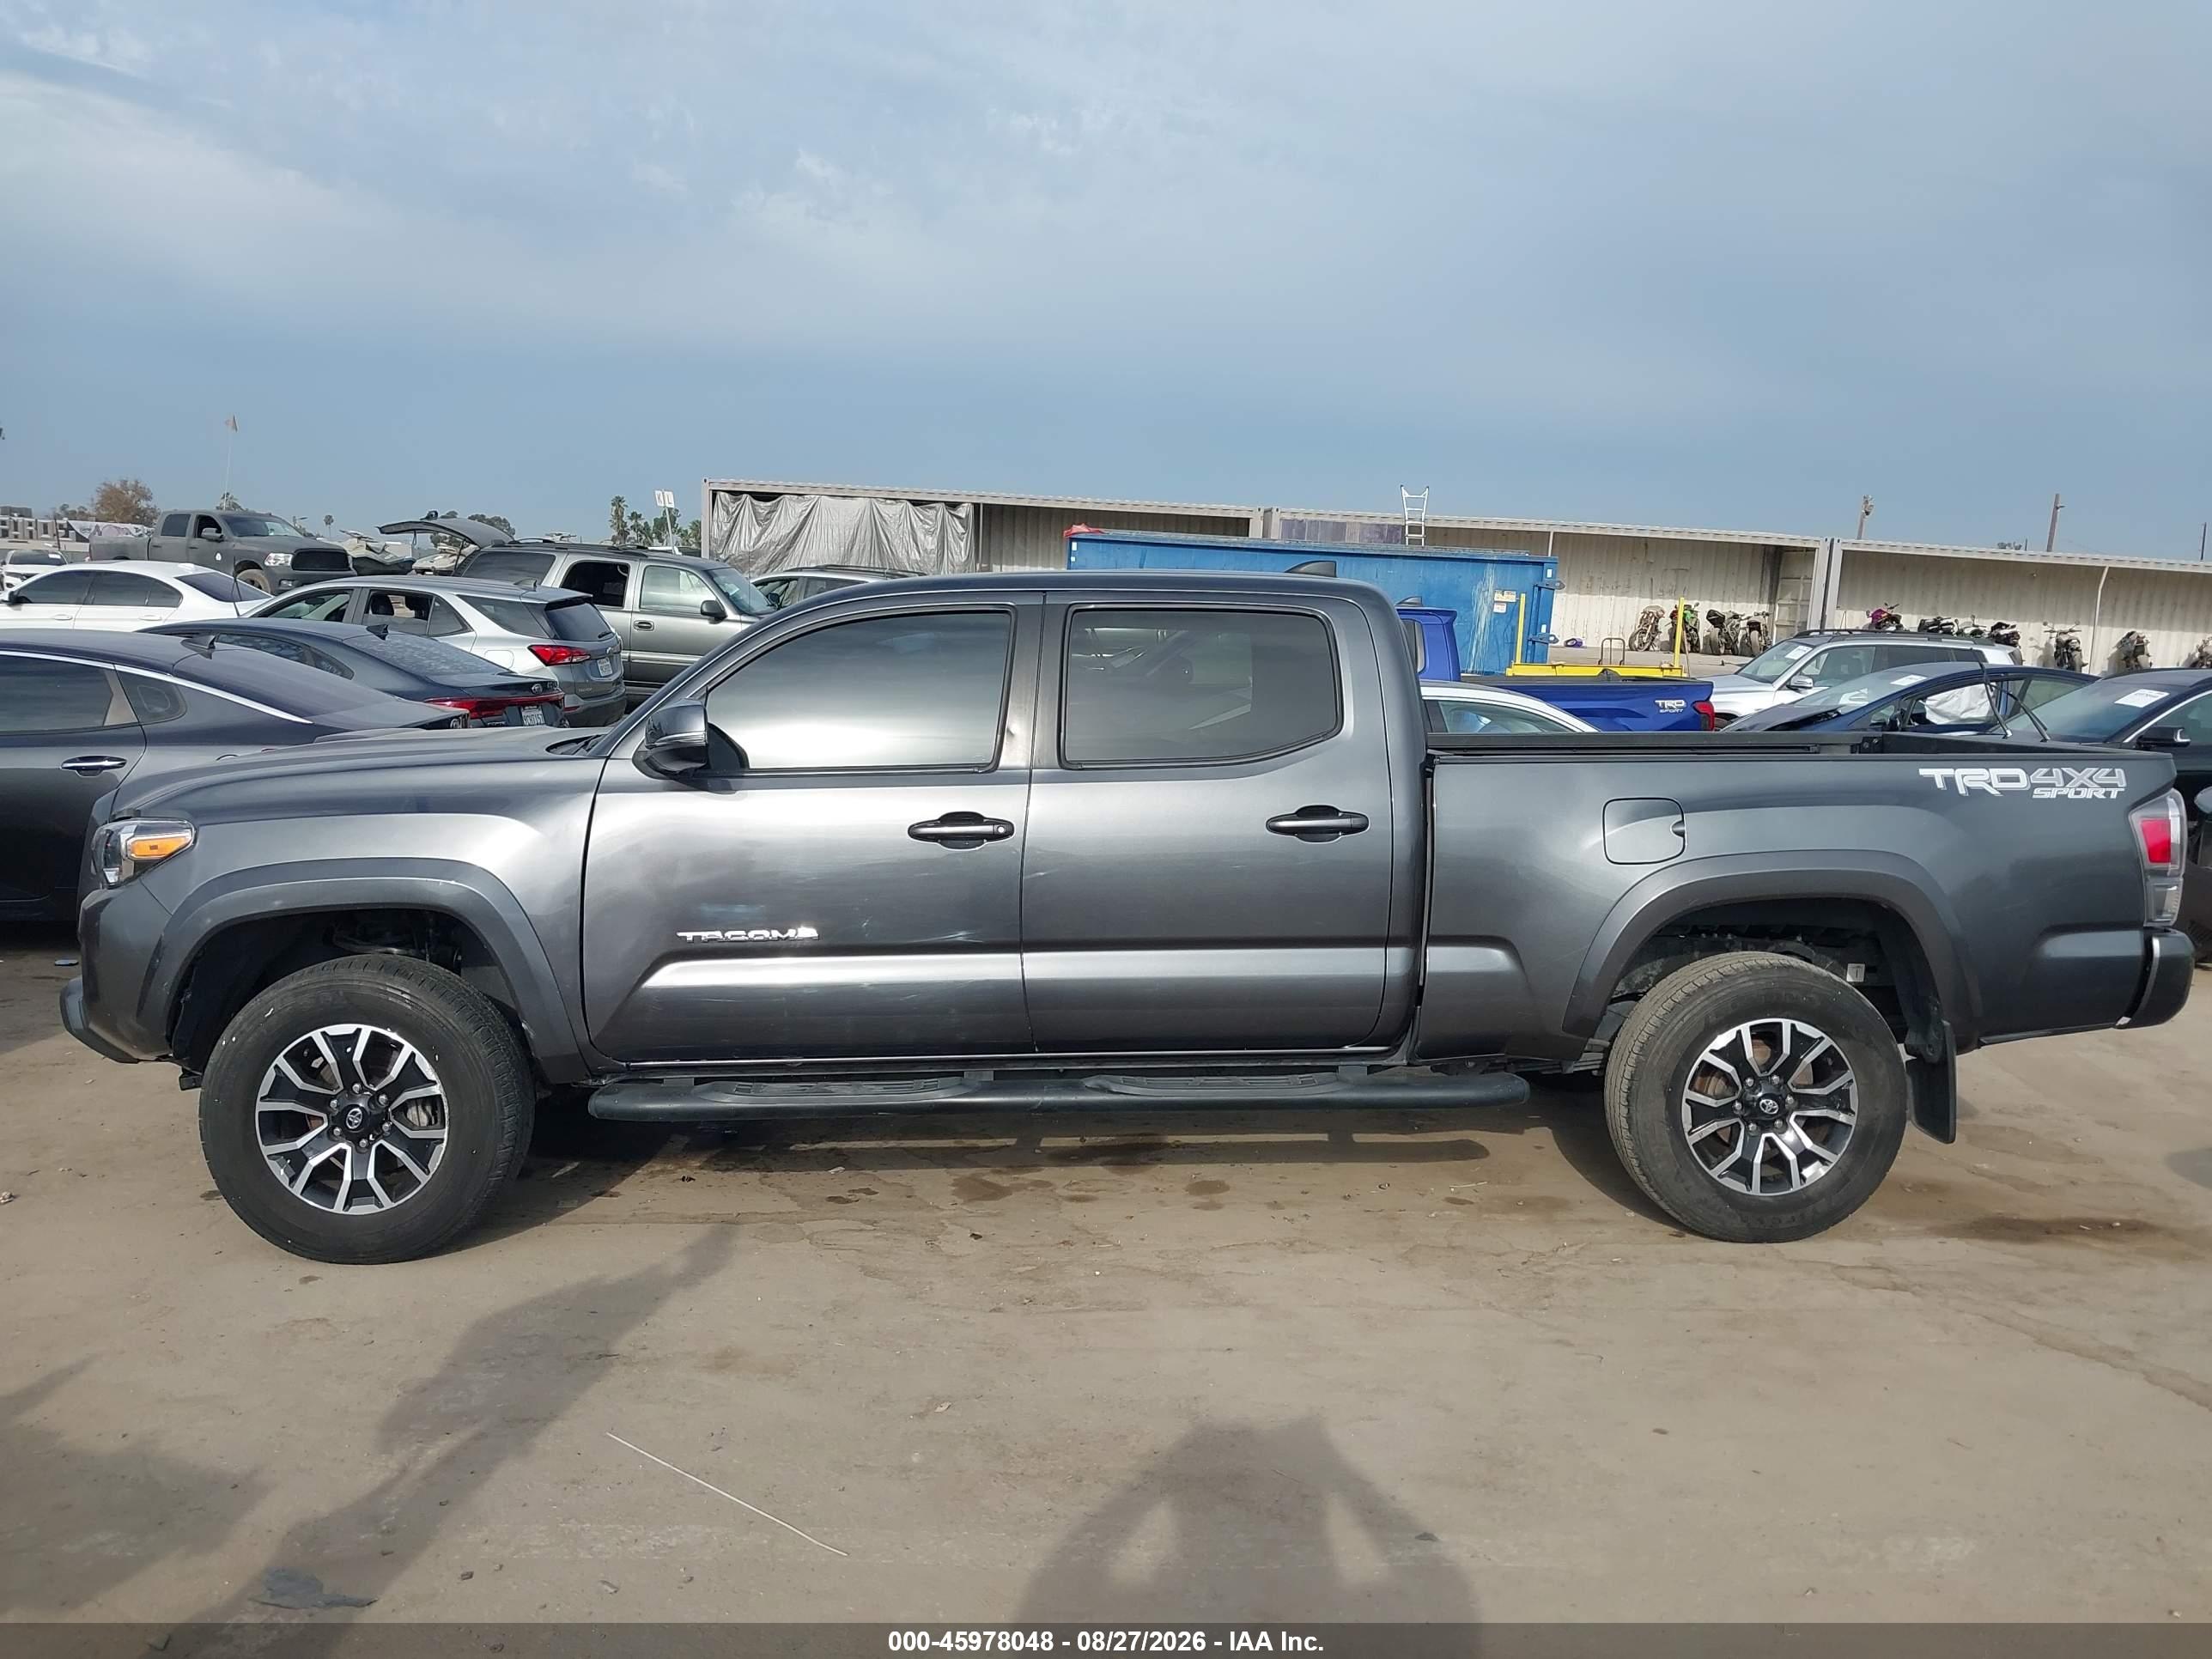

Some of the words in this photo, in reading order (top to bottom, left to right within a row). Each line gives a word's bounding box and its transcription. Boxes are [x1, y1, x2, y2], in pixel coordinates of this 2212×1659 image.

[1655, 699, 1686, 708] TRD
[1918, 768, 2030, 796] TRD
[2032, 787, 2125, 799] SPORT
